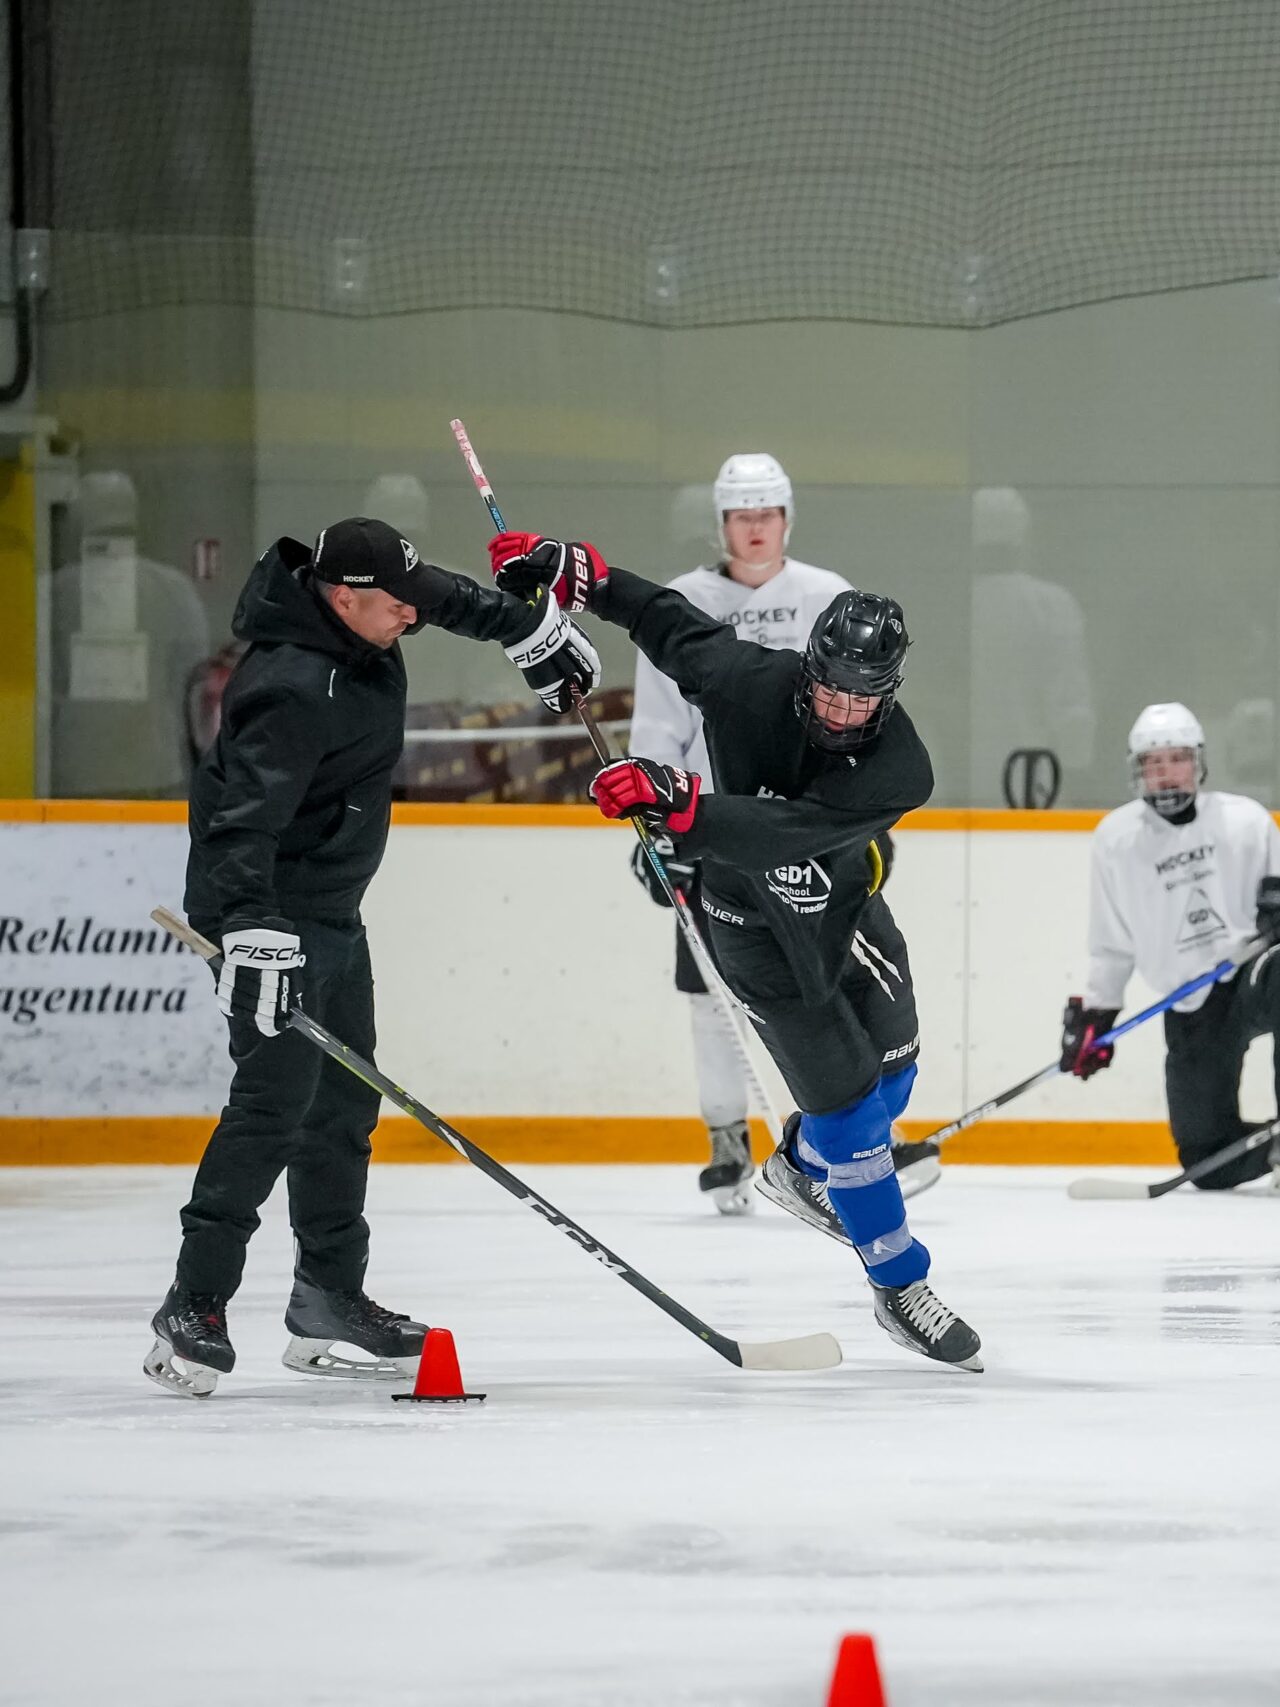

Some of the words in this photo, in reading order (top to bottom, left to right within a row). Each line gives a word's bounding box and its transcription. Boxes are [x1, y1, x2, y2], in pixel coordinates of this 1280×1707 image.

[343, 575, 375, 583] HOCKEY
[570, 546, 589, 613] BAUE
[513, 612, 569, 666] FISCH
[774, 865, 812, 885] GD1
[782, 886, 811, 896] hool
[0, 916, 200, 955] Reklamn
[229, 944, 300, 961] FISCH
[852, 1143, 887, 1159] BAUER
